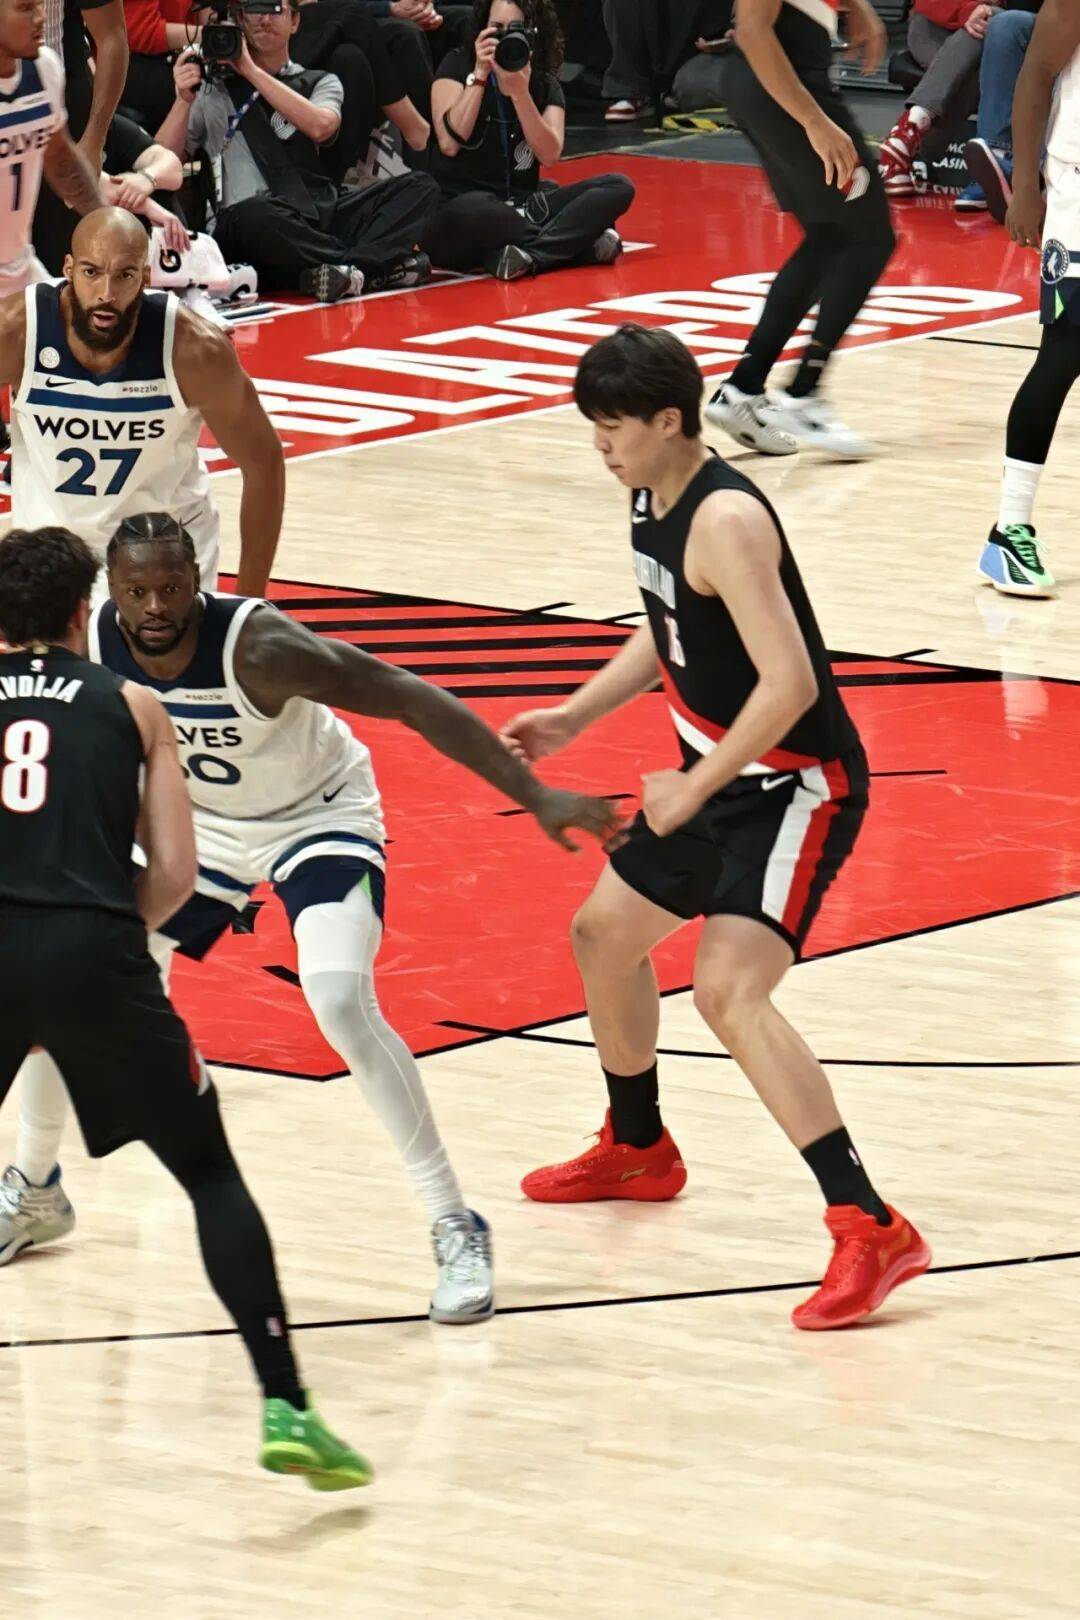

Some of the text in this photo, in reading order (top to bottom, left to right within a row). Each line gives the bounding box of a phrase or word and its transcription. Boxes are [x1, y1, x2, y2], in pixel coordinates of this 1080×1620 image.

[34, 414, 165, 441] WOLVES
[54, 447, 143, 496] 27
[3, 719, 50, 812] 8
[181, 753, 242, 785] 0
